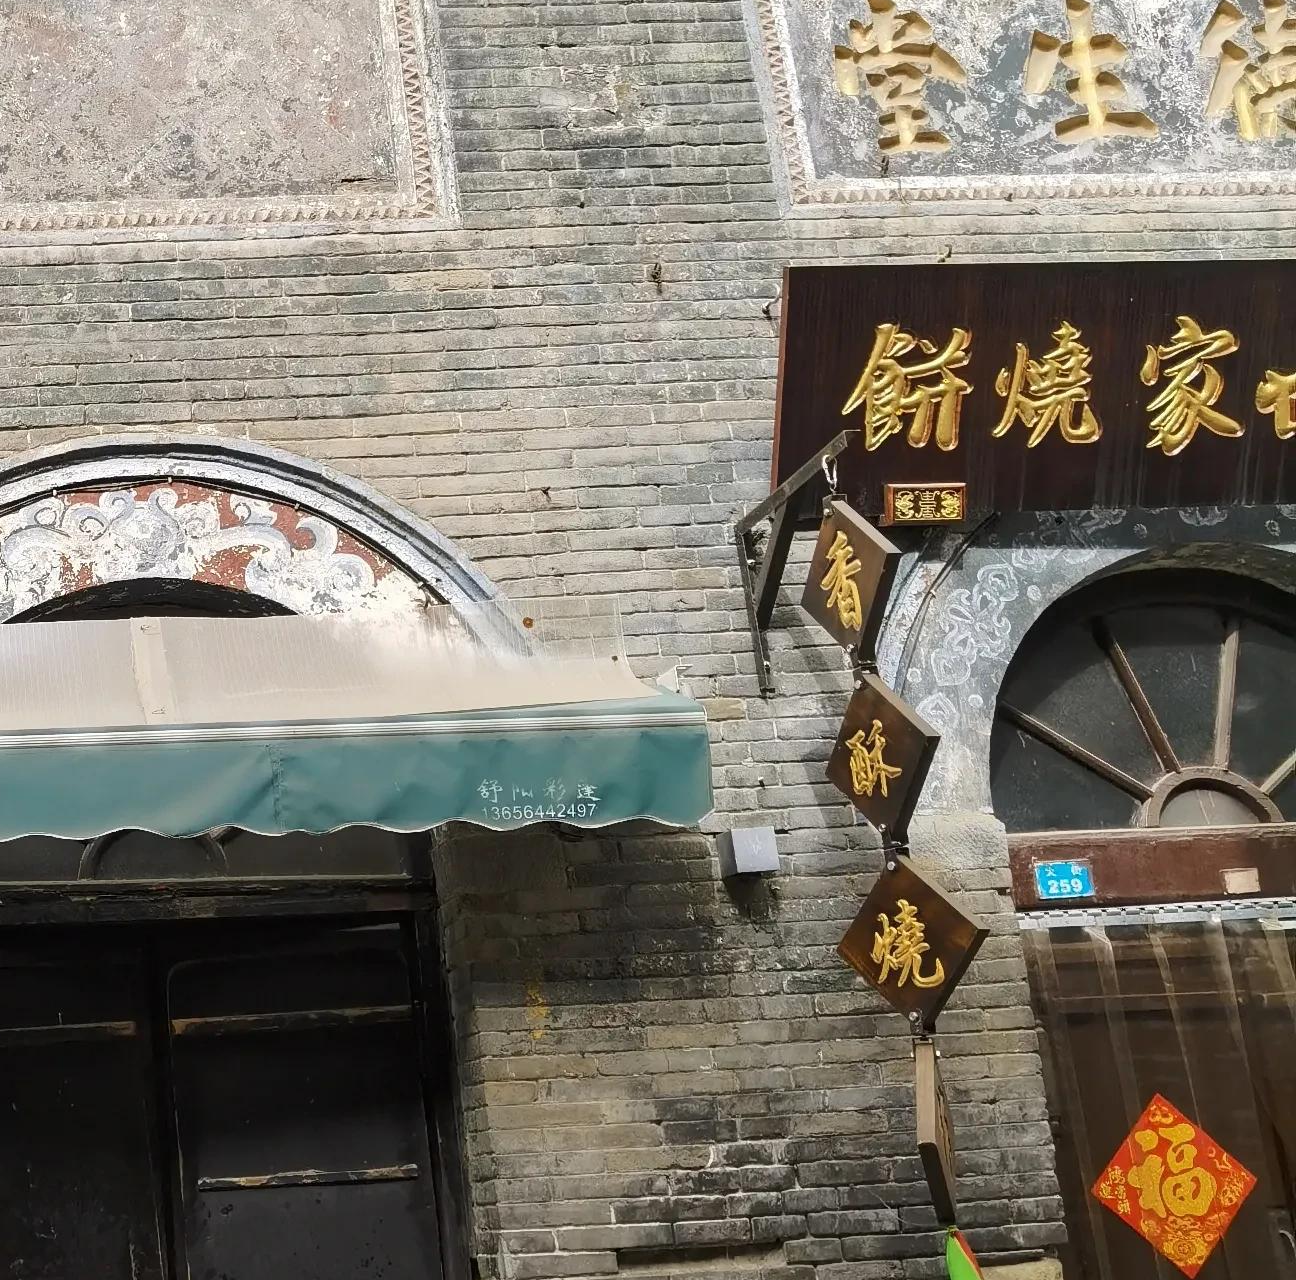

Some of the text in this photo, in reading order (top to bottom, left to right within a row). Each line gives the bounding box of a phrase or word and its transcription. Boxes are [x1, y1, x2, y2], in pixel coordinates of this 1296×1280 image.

[481, 803, 597, 821] 13656442497
[1048, 877, 1083, 894] 259
[1127, 1123, 1218, 1219] 福
